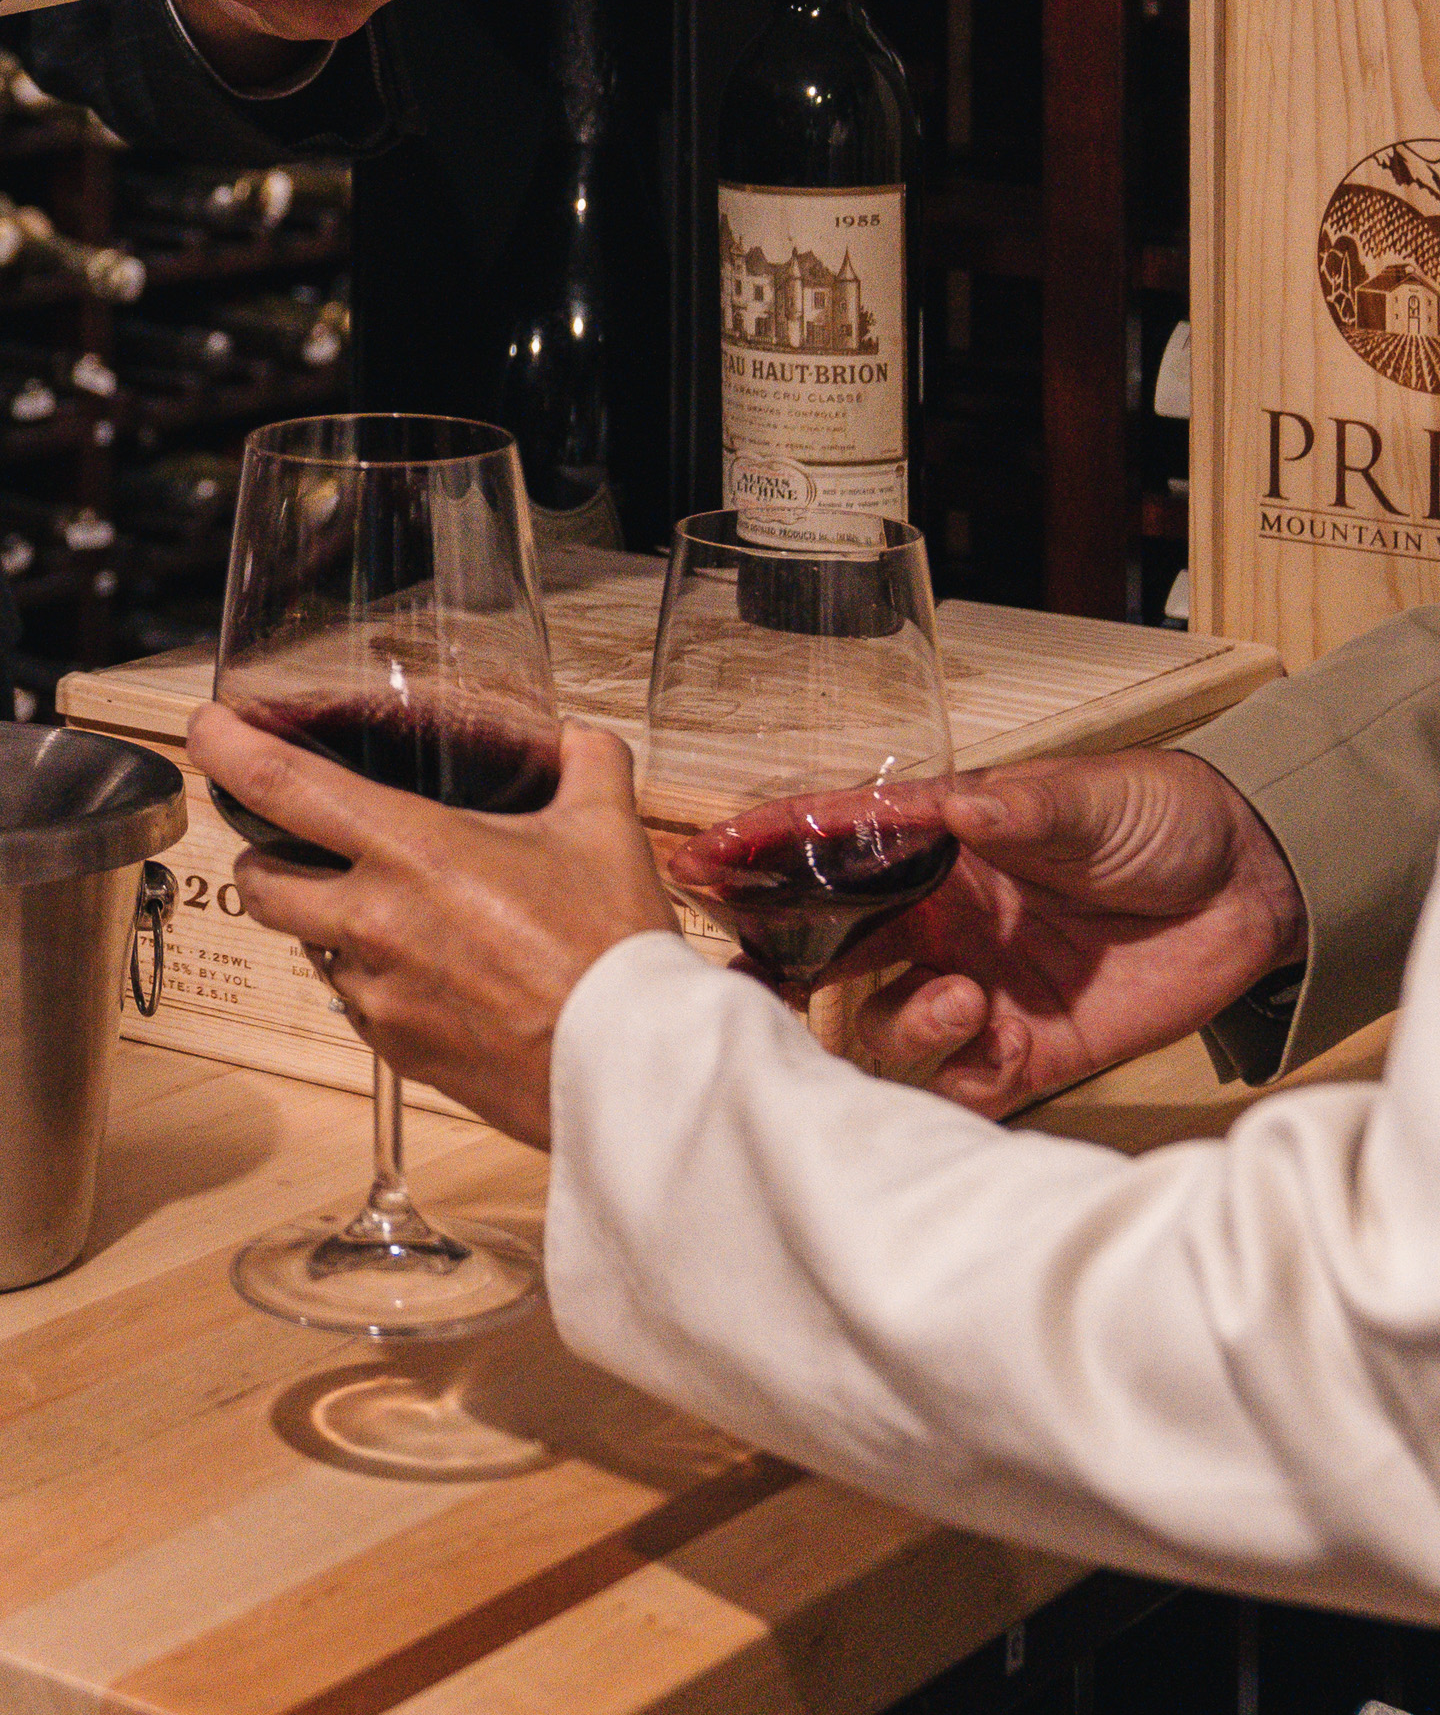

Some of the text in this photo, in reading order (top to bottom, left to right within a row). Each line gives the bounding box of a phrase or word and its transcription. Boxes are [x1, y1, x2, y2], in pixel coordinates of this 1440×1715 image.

[773, 391, 801, 402] CRU
[743, 473, 790, 488] ALEXIS
[737, 481, 798, 501] LICHINE
[1260, 512, 1423, 553] MOUNTAIN
[139, 936, 183, 954] 75ML
[199, 968, 216, 979] BY
[223, 973, 257, 989] VOL.
